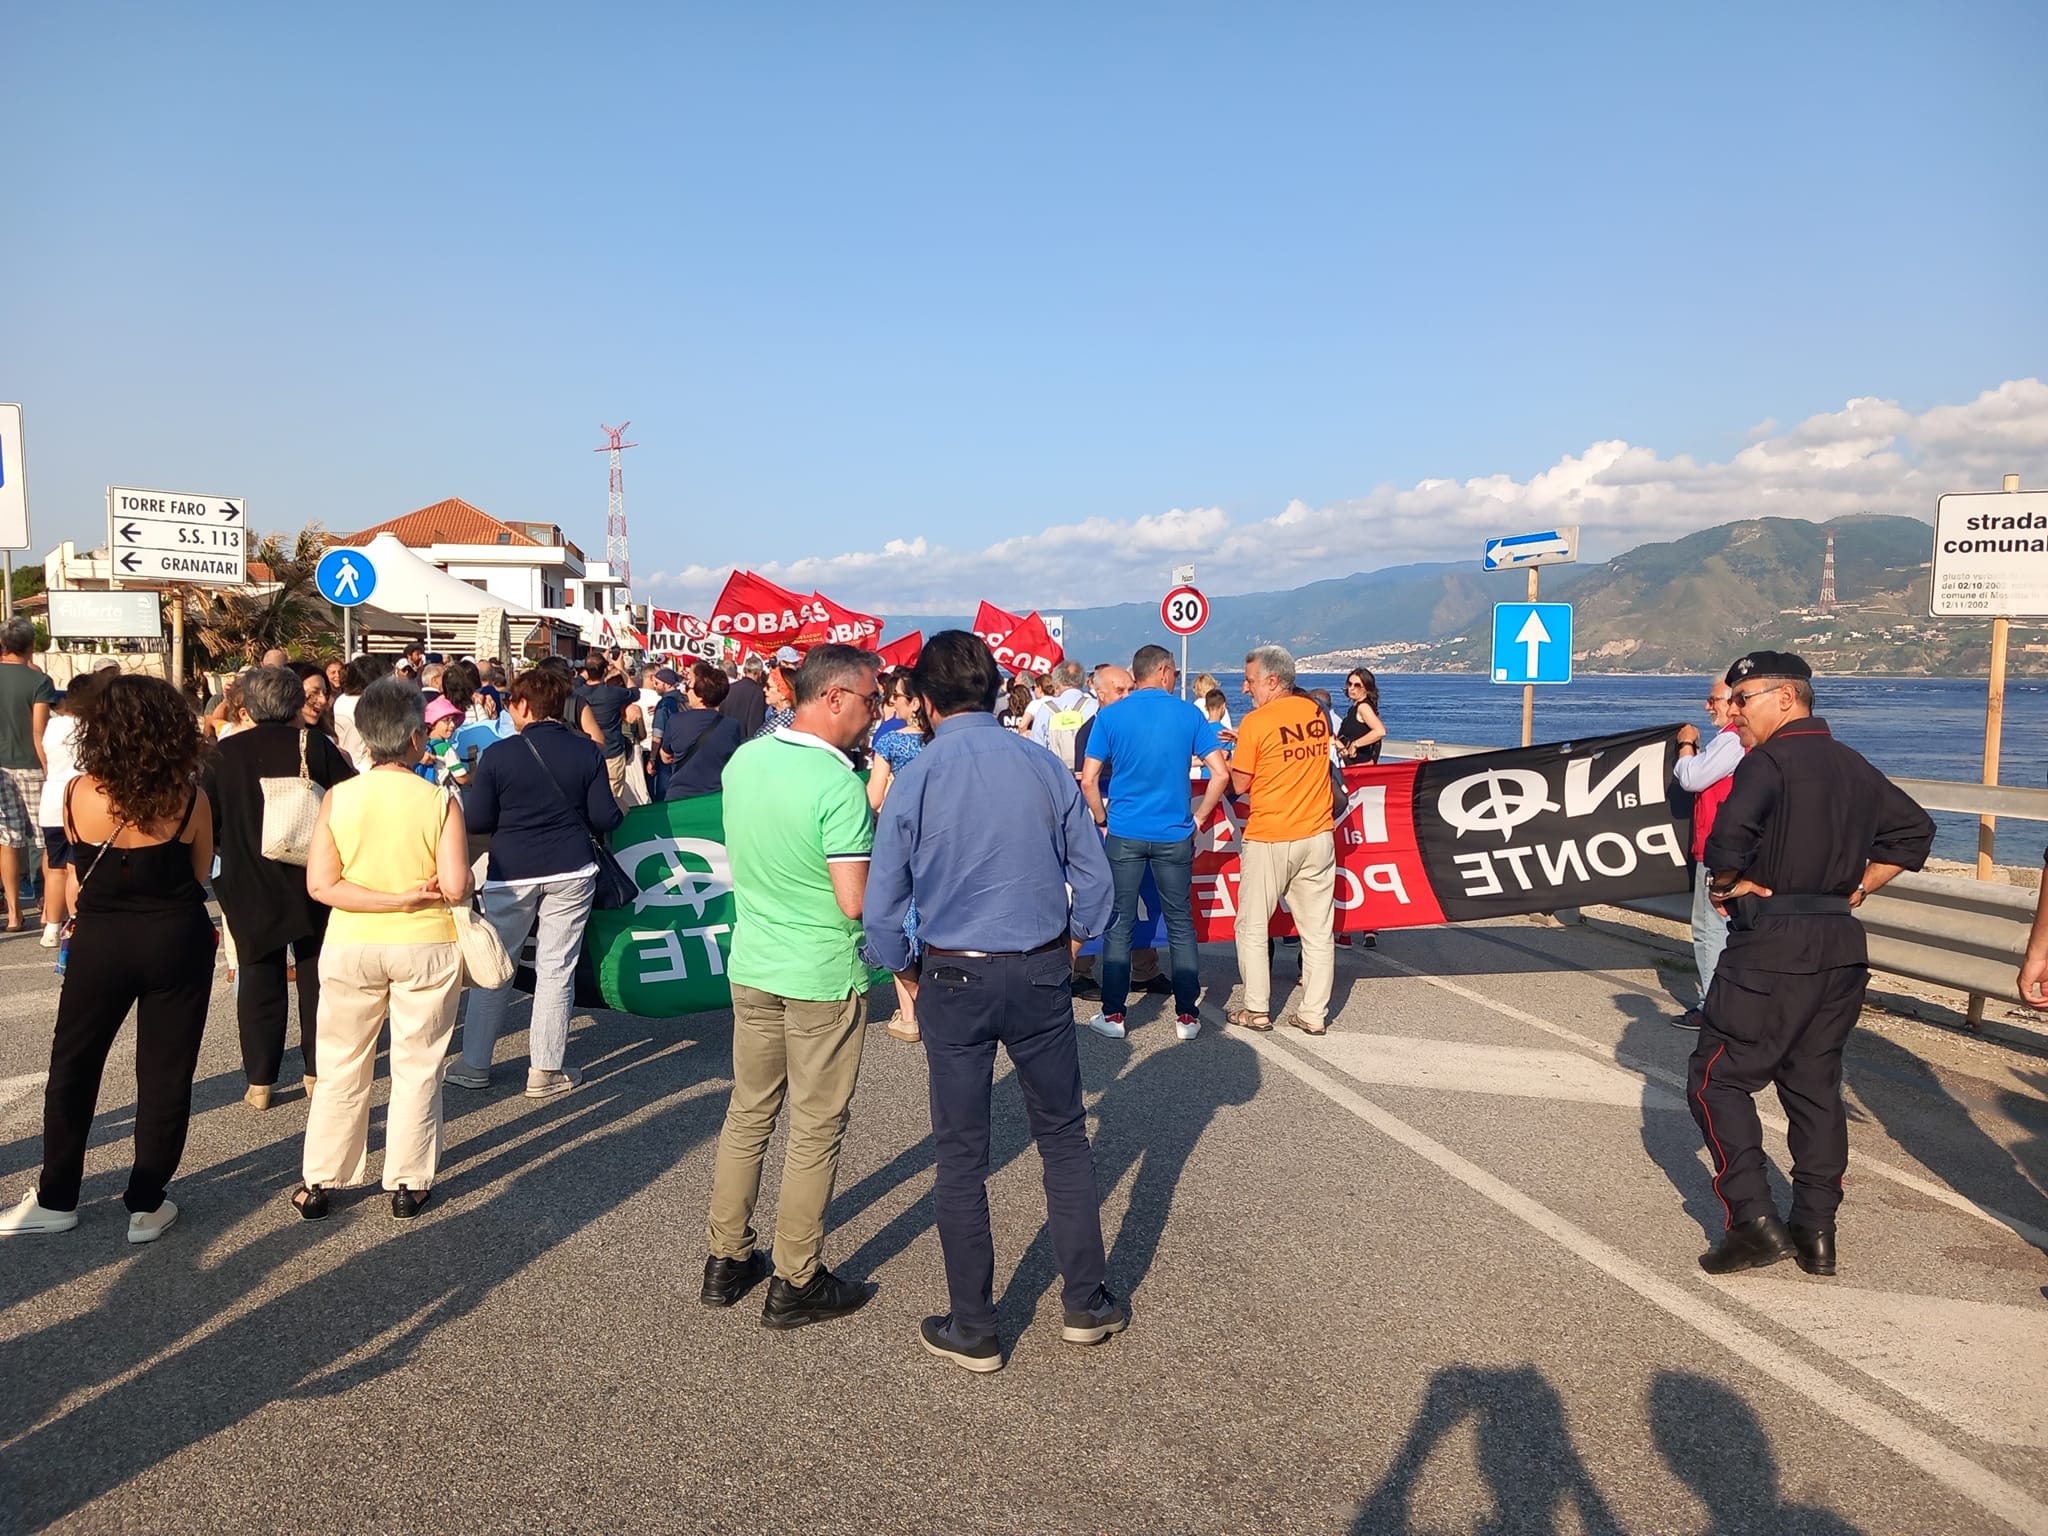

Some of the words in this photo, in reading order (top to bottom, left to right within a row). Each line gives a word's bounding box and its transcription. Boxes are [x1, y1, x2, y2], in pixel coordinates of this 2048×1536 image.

[121, 496, 166, 513] TORRE
[170, 500, 206, 516] FARO
[1966, 512, 2047, 530] strada
[178, 528, 204, 544] S.S.
[212, 530, 239, 547] 113
[161, 556, 238, 575] GRANATARI
[1941, 582, 1956, 590] del
[1978, 591, 1988, 599] di
[1172, 600, 1198, 622] 30
[1941, 601, 1989, 609] 12/11/2002
[826, 619, 876, 644] OBAS
[650, 634, 715, 657] MUOS
[993, 647, 1052, 674] COB
[1279, 719, 1327, 745] NO
[1283, 742, 1328, 762] PONTE
